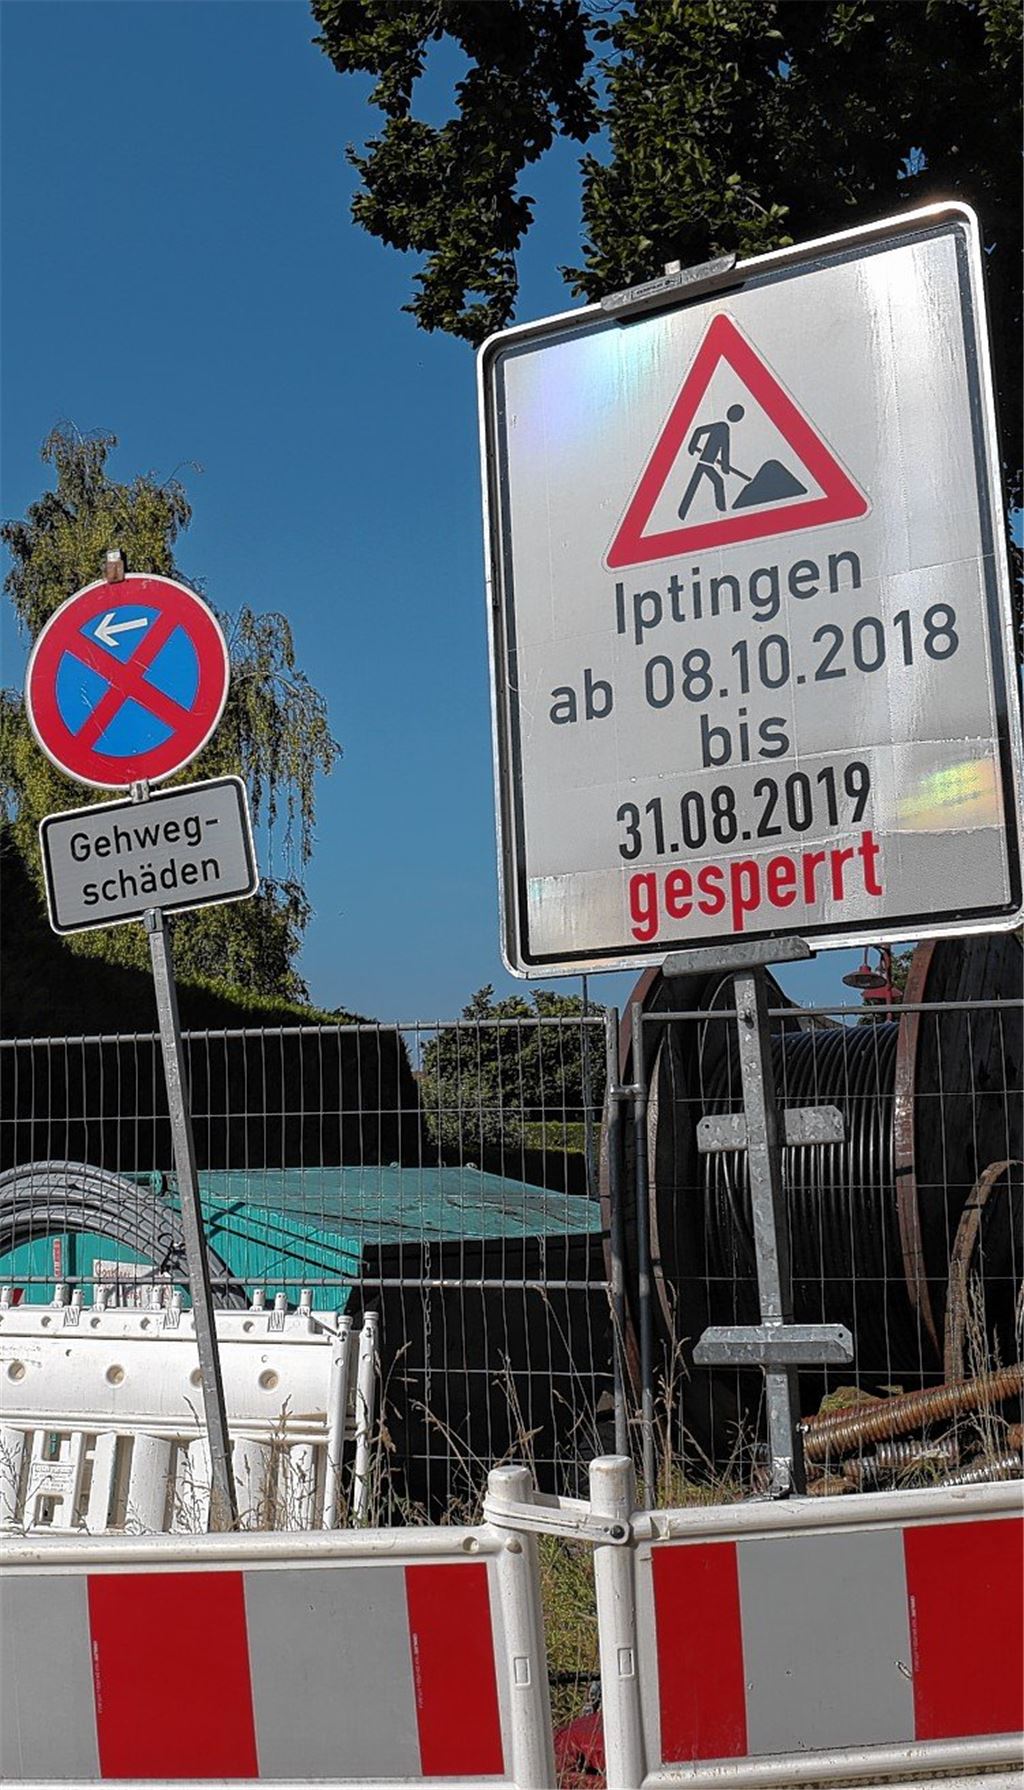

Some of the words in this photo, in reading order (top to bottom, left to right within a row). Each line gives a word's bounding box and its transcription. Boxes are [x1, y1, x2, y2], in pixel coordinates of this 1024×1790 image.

[615, 550, 862, 647] Iptingen
[549, 668, 614, 726] ab
[644, 603, 959, 710] 08.10.2018
[700, 708, 790, 768] bis
[70, 815, 219, 863] Gehweg-
[616, 761, 871, 861] 31.08.2019
[82, 858, 220, 906] schäden
[629, 831, 883, 942] gesperrt
